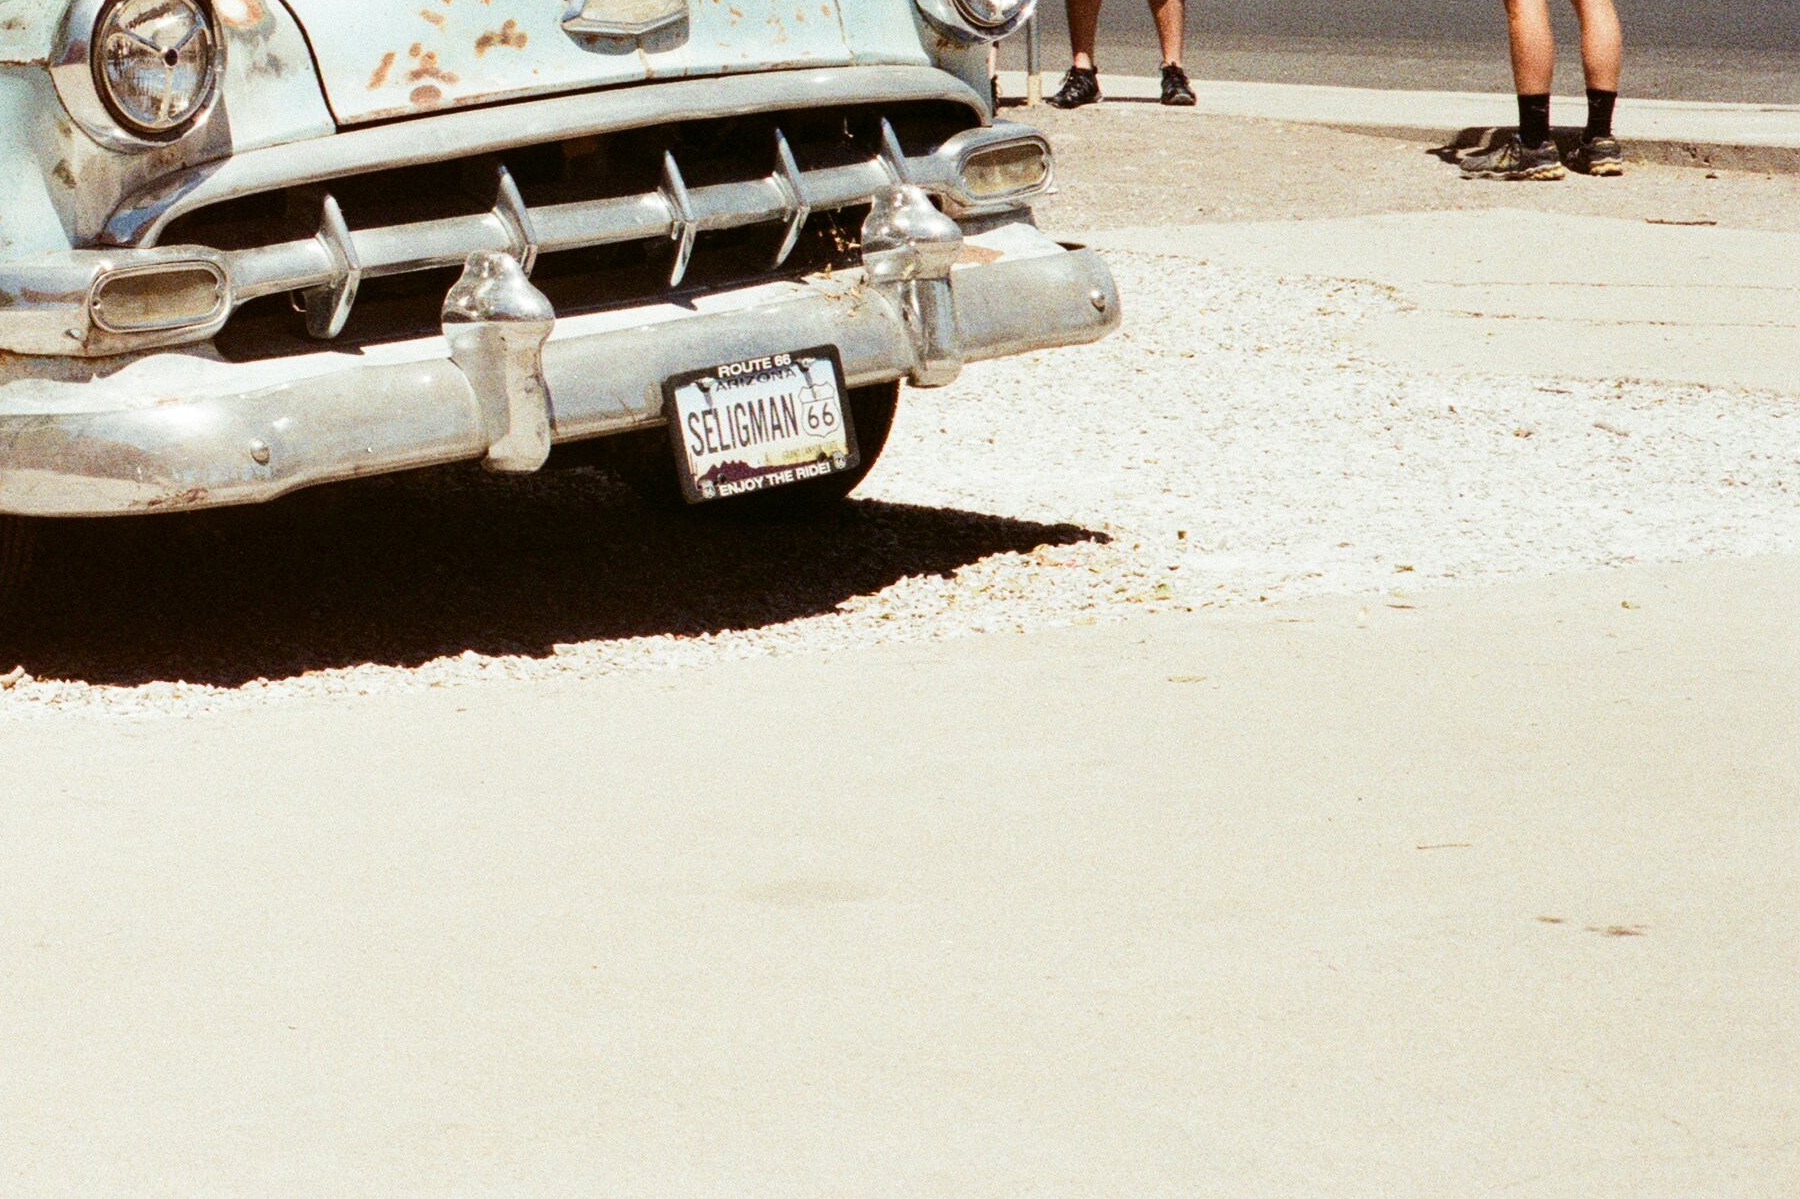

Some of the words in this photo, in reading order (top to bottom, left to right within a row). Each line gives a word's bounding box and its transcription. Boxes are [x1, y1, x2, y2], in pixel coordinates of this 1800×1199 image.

[718, 357, 772, 378] ROUTE
[774, 354, 792, 367] 66
[687, 393, 799, 457] SELIGMAN
[808, 404, 835, 430] 66
[719, 476, 764, 497] ENJOY
[766, 470, 794, 487] THE
[796, 462, 831, 480] RIDE!
